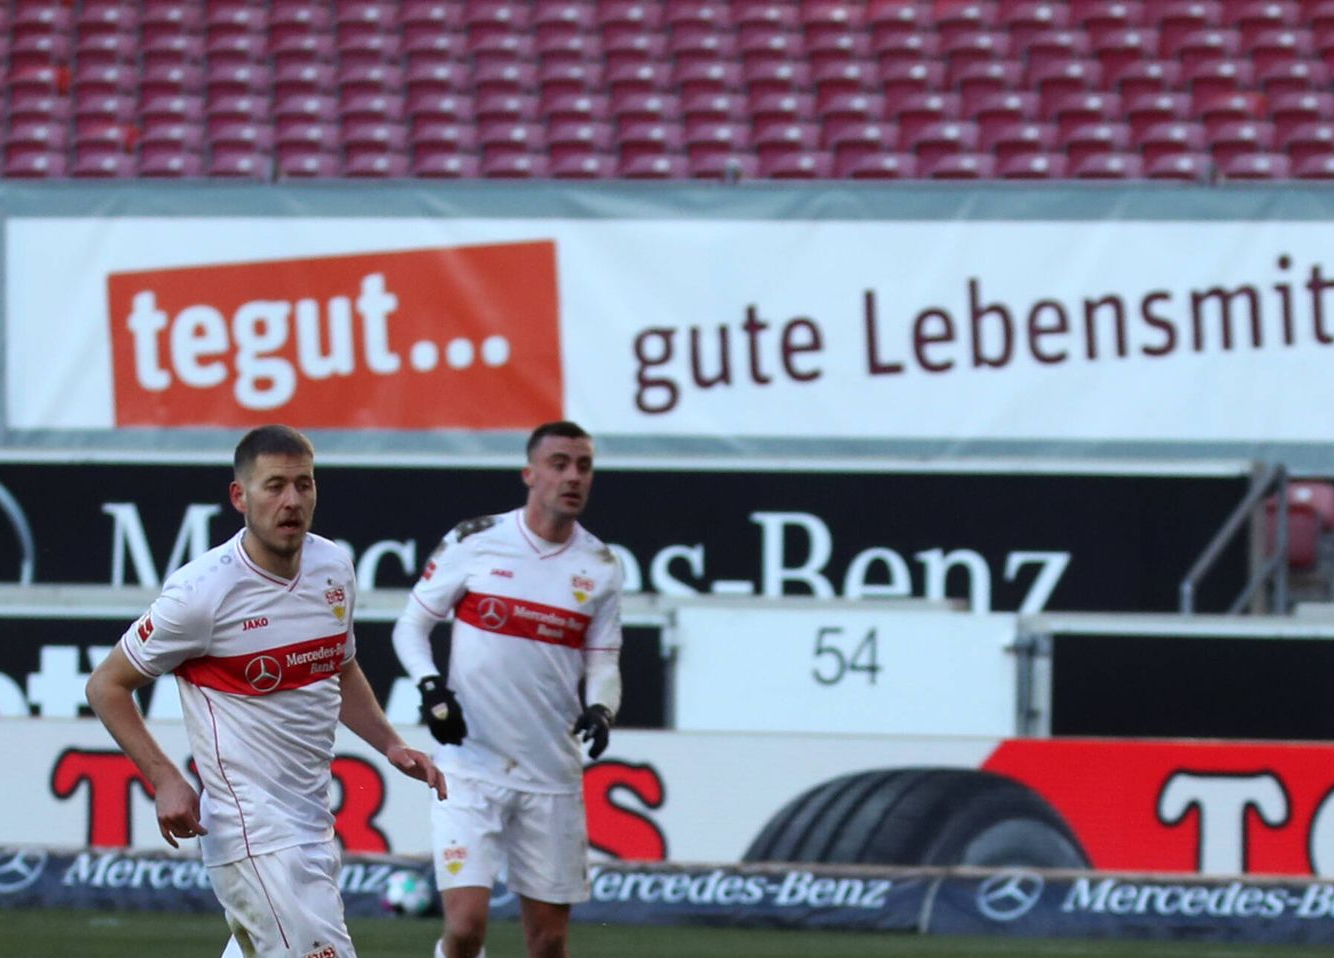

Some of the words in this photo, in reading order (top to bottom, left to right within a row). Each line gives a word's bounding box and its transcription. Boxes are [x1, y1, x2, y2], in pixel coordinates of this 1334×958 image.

[127, 272, 511, 410] tegut...
[631, 303, 823, 414] gute
[242, 617, 269, 631] JAKO
[310, 659, 335, 674] Bank
[811, 627, 881, 685] 54
[588, 866, 891, 908] ercedes-Benz
